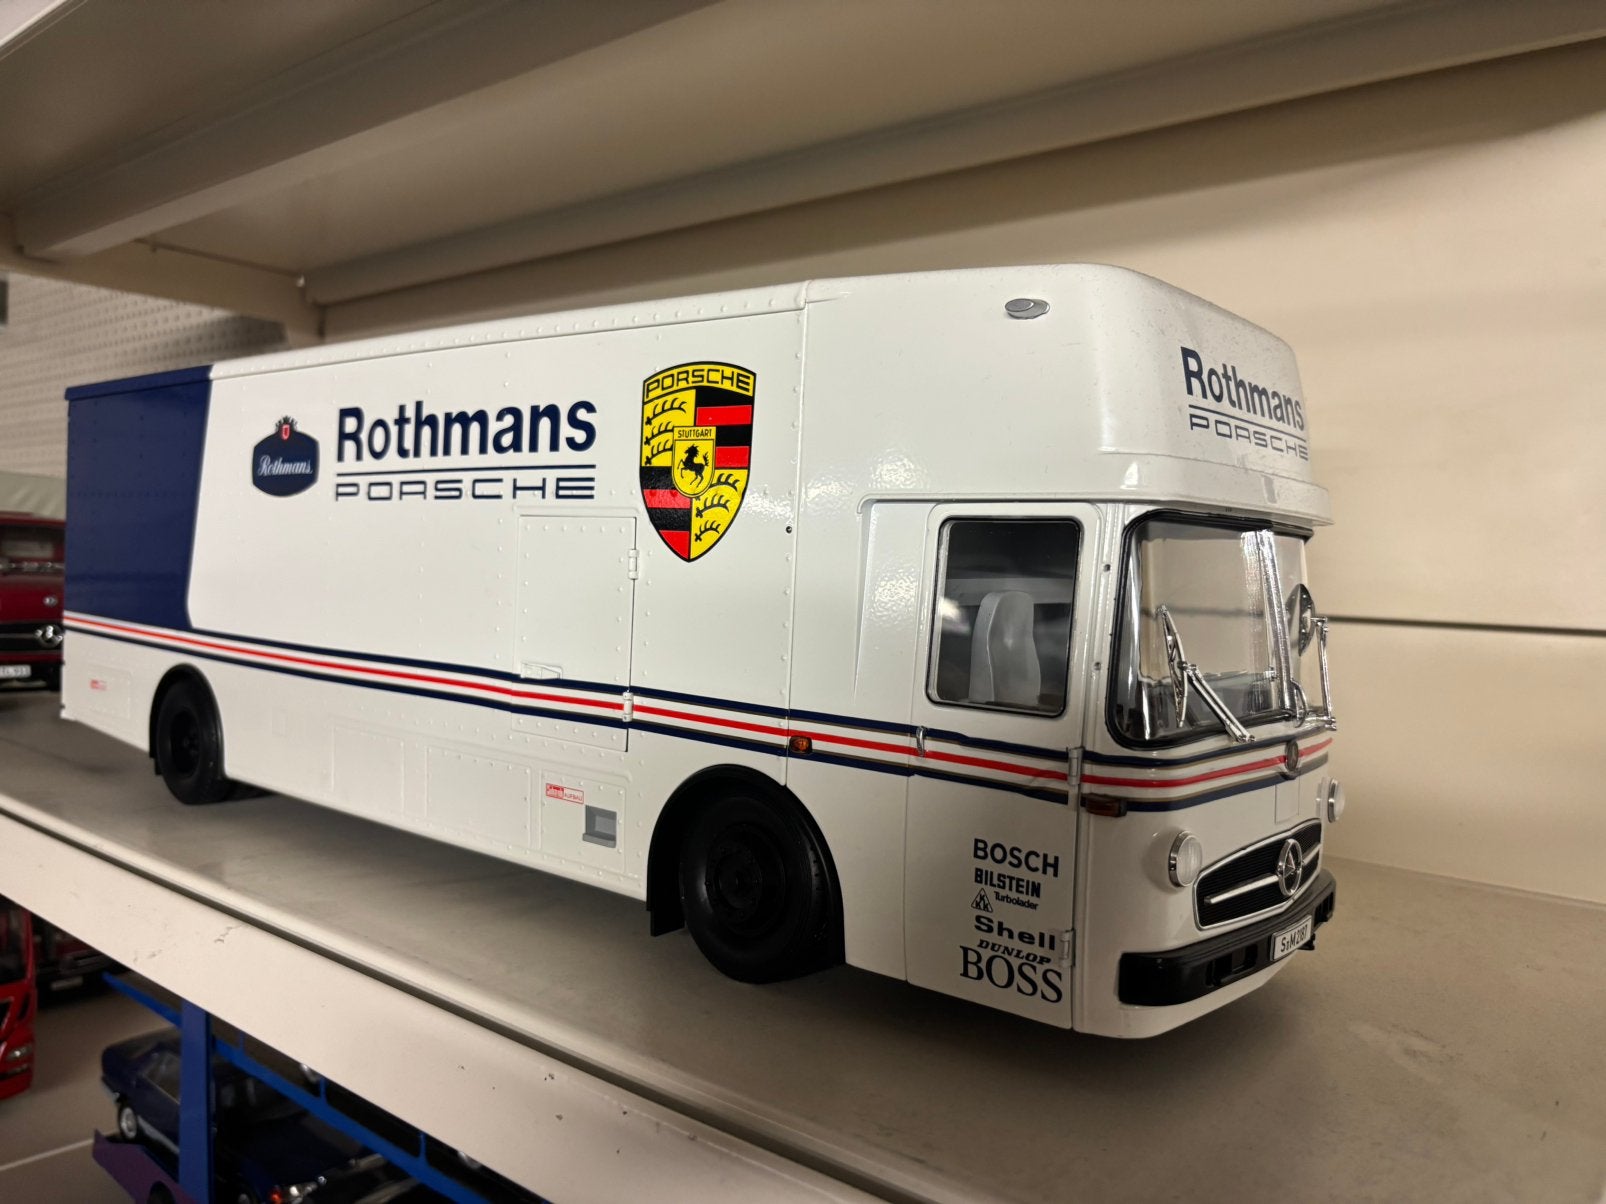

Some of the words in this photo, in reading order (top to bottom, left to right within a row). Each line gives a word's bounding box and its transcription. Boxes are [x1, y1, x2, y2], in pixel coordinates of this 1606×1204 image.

[646, 369, 751, 398] PORSCHE
[1180, 346, 1305, 431] Rothmans
[337, 400, 597, 462] Rothmans
[677, 428, 713, 439] STUTTGART
[1189, 413, 1309, 461] PORSCHE
[258, 455, 313, 476] Rothmans
[335, 477, 596, 502] PORSCHE
[973, 838, 1060, 878] BOSCH
[974, 867, 1042, 899] BILSTEIN
[994, 890, 1039, 911] Turbolader
[974, 914, 1056, 951] Shell
[977, 938, 1052, 966] DUNLOP
[959, 945, 1063, 1004] BOSS
